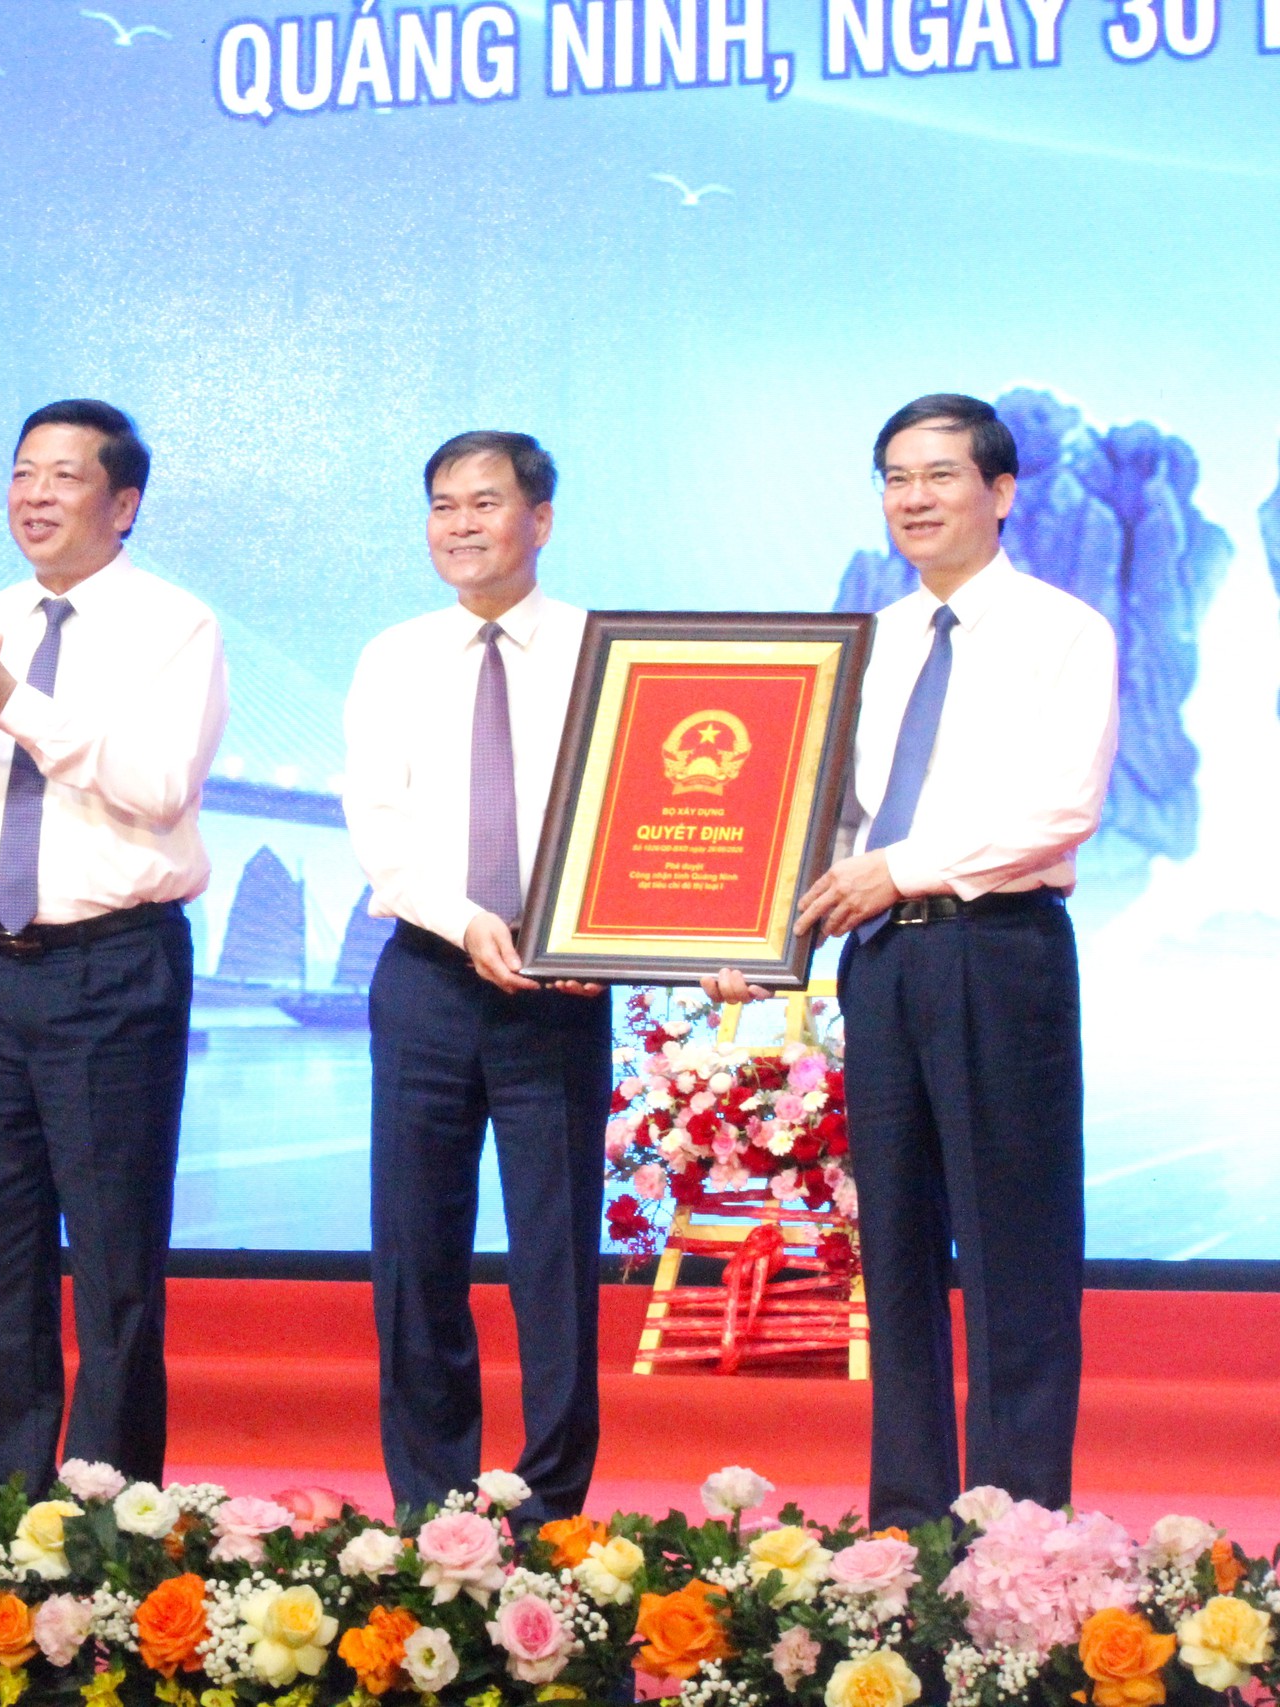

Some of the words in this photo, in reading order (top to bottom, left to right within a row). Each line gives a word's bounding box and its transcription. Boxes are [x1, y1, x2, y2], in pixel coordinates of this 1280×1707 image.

[550, 0, 790, 95] NINH,
[1107, 0, 1216, 59] 30
[662, 807, 676, 816] BỘ
[677, 806, 697, 816] XÂY
[697, 808, 725, 817] DỰNG
[636, 822, 698, 840] QUYẾT
[700, 826, 744, 844] ĐỊNH
